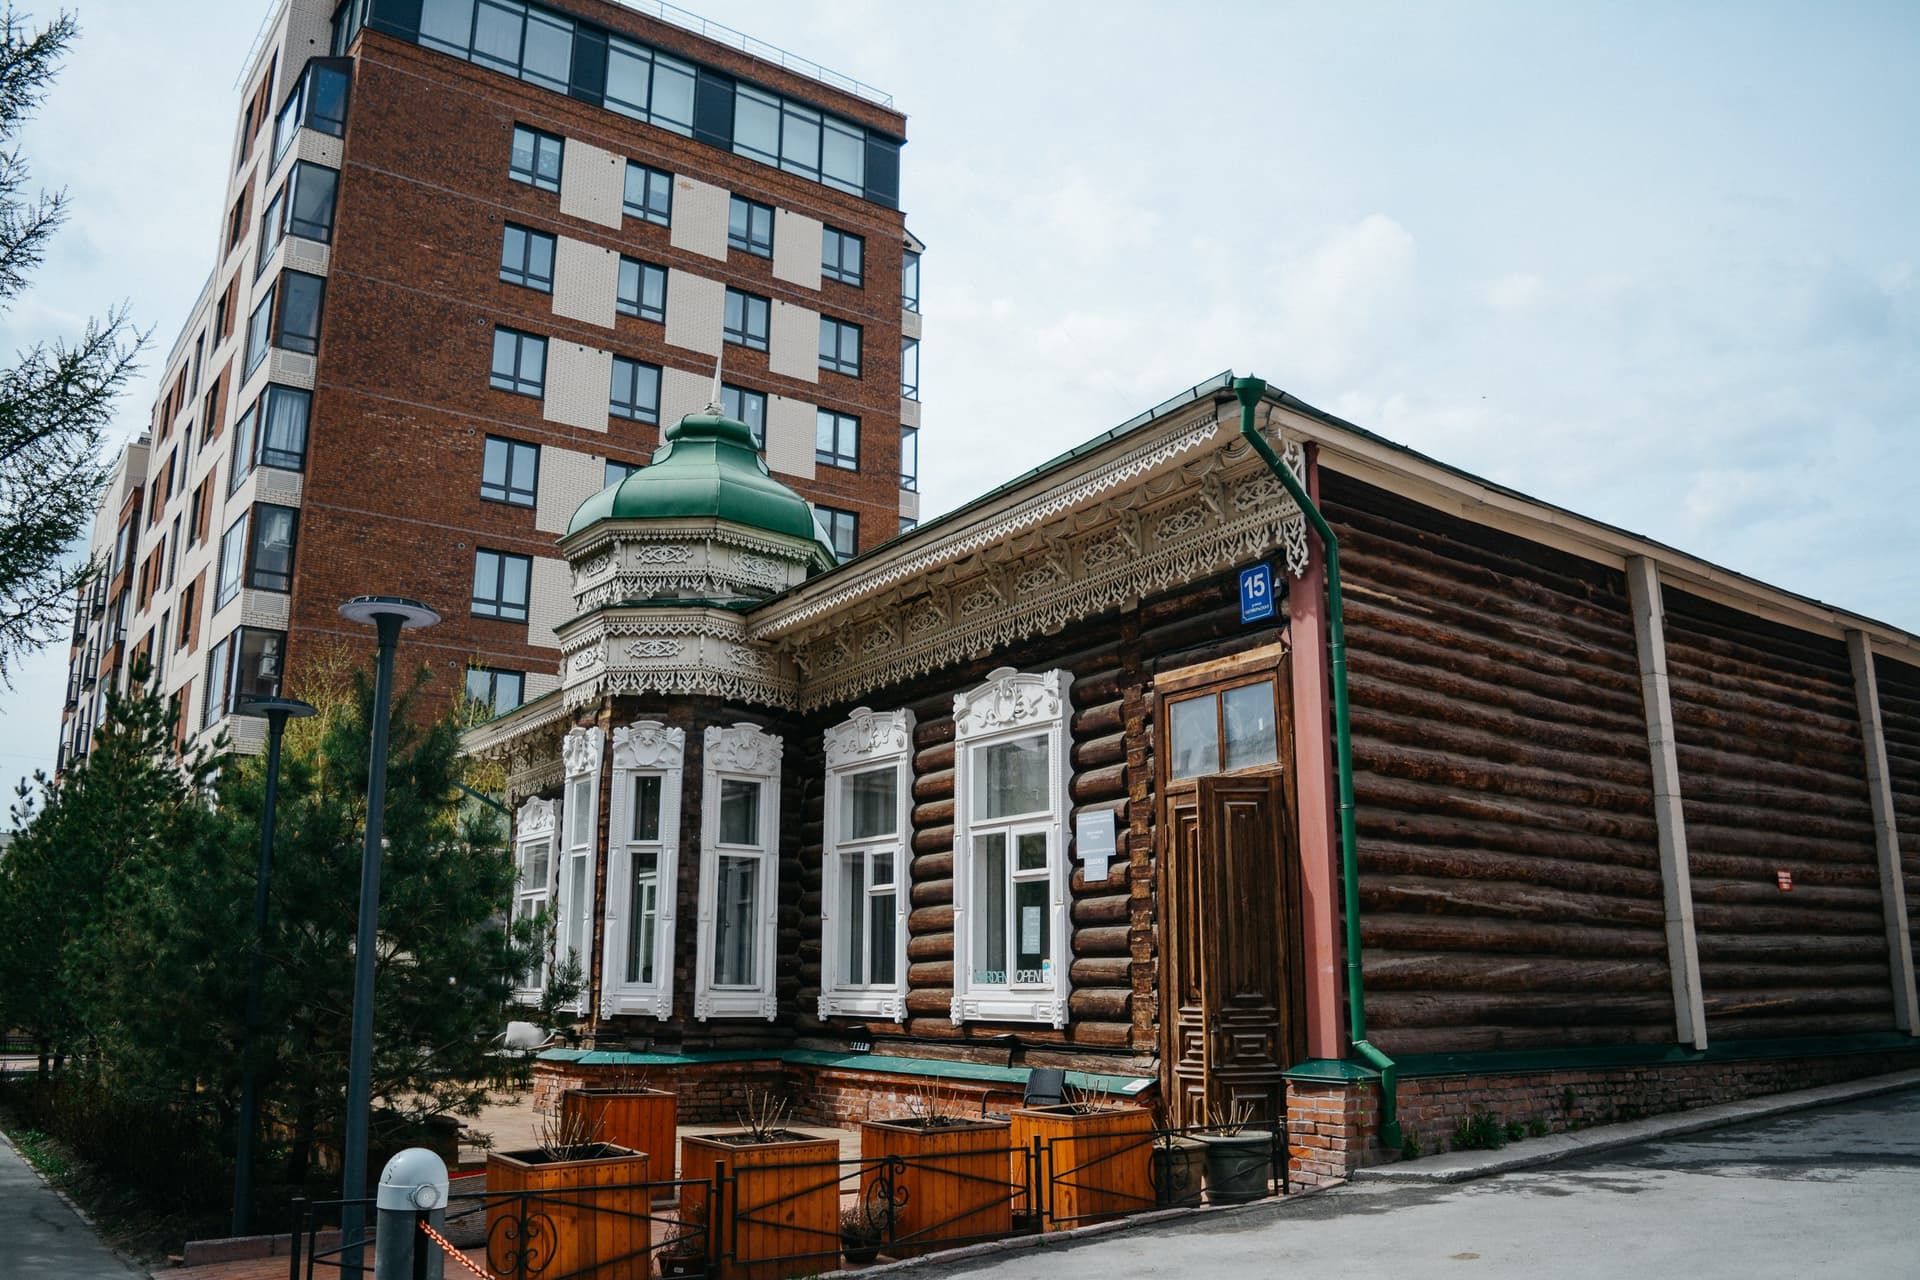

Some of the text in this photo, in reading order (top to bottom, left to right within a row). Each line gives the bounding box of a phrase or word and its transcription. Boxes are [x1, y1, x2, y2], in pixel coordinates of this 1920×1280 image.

[1244, 573, 1265, 599] 15
[976, 970, 1007, 983] RDEN
[1016, 970, 1041, 983] OPEN
